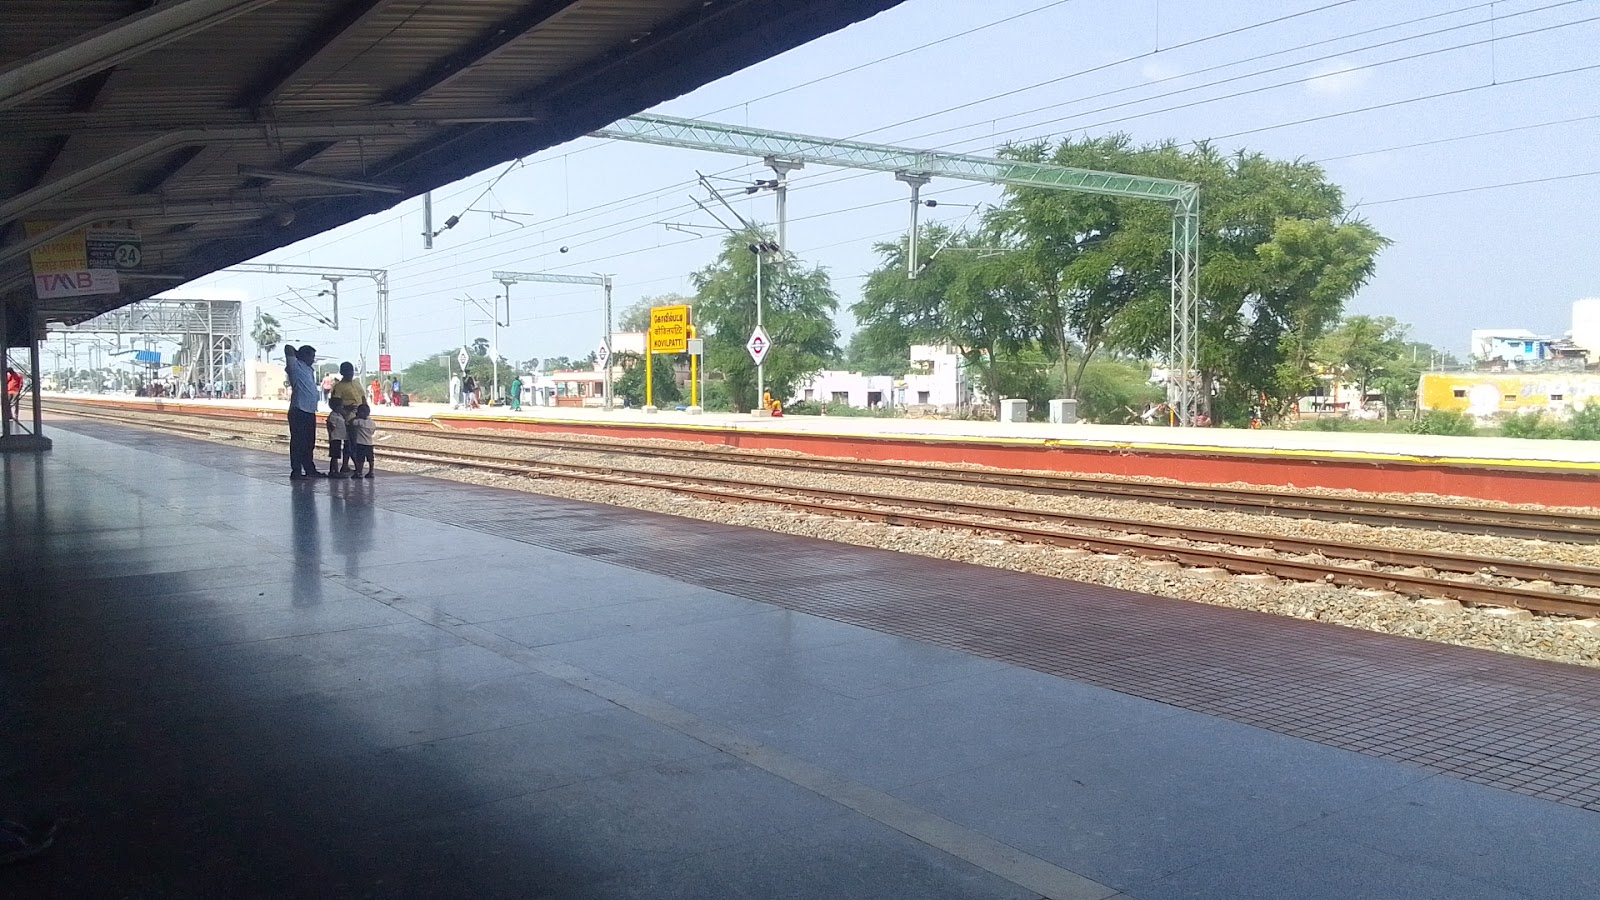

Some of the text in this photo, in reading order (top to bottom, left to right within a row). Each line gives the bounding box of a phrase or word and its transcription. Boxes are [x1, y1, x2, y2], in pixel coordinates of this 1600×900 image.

[119, 248, 136, 263] 24
[37, 272, 93, 291] TMB
[654, 339, 684, 348] KOVILPATTI
